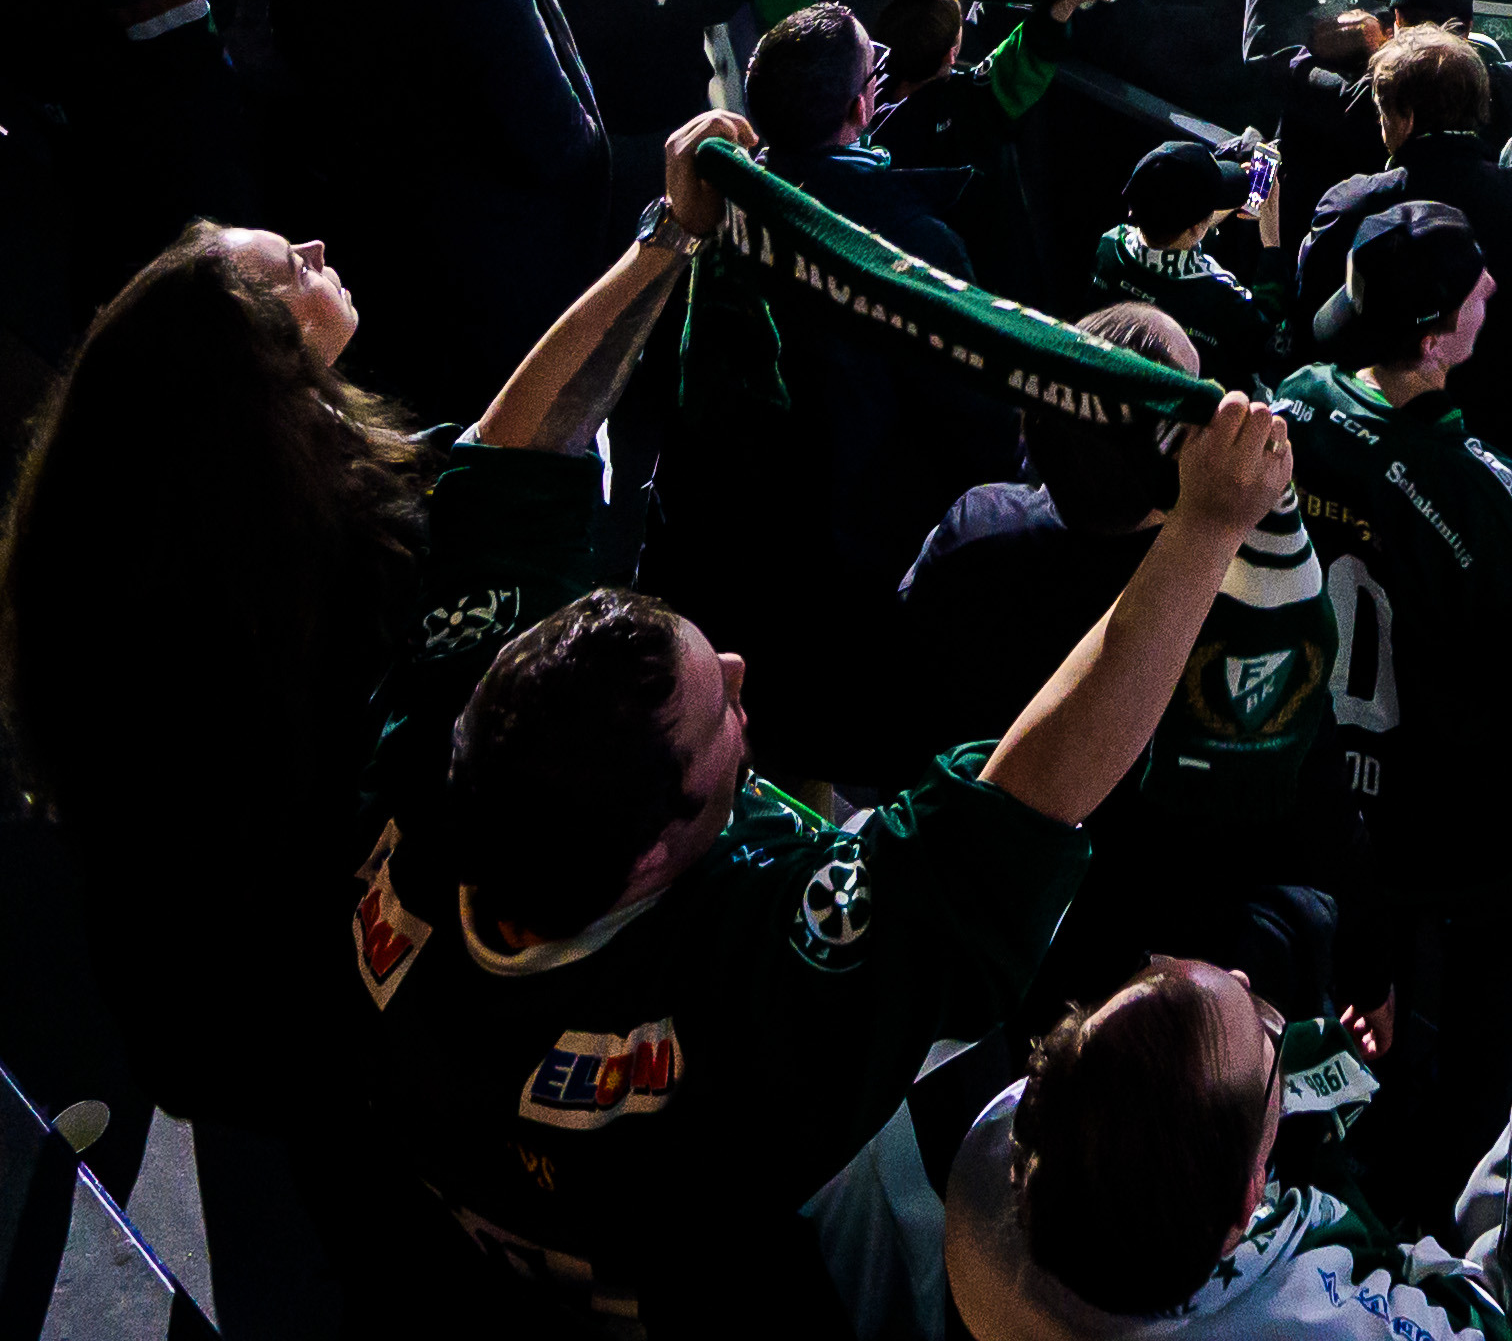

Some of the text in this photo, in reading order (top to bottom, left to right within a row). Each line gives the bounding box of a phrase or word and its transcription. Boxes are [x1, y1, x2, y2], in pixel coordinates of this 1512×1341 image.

[1330, 410, 1380, 446] CCM
[1234, 659, 1276, 696] F
[529, 1034, 675, 1111] ELON
